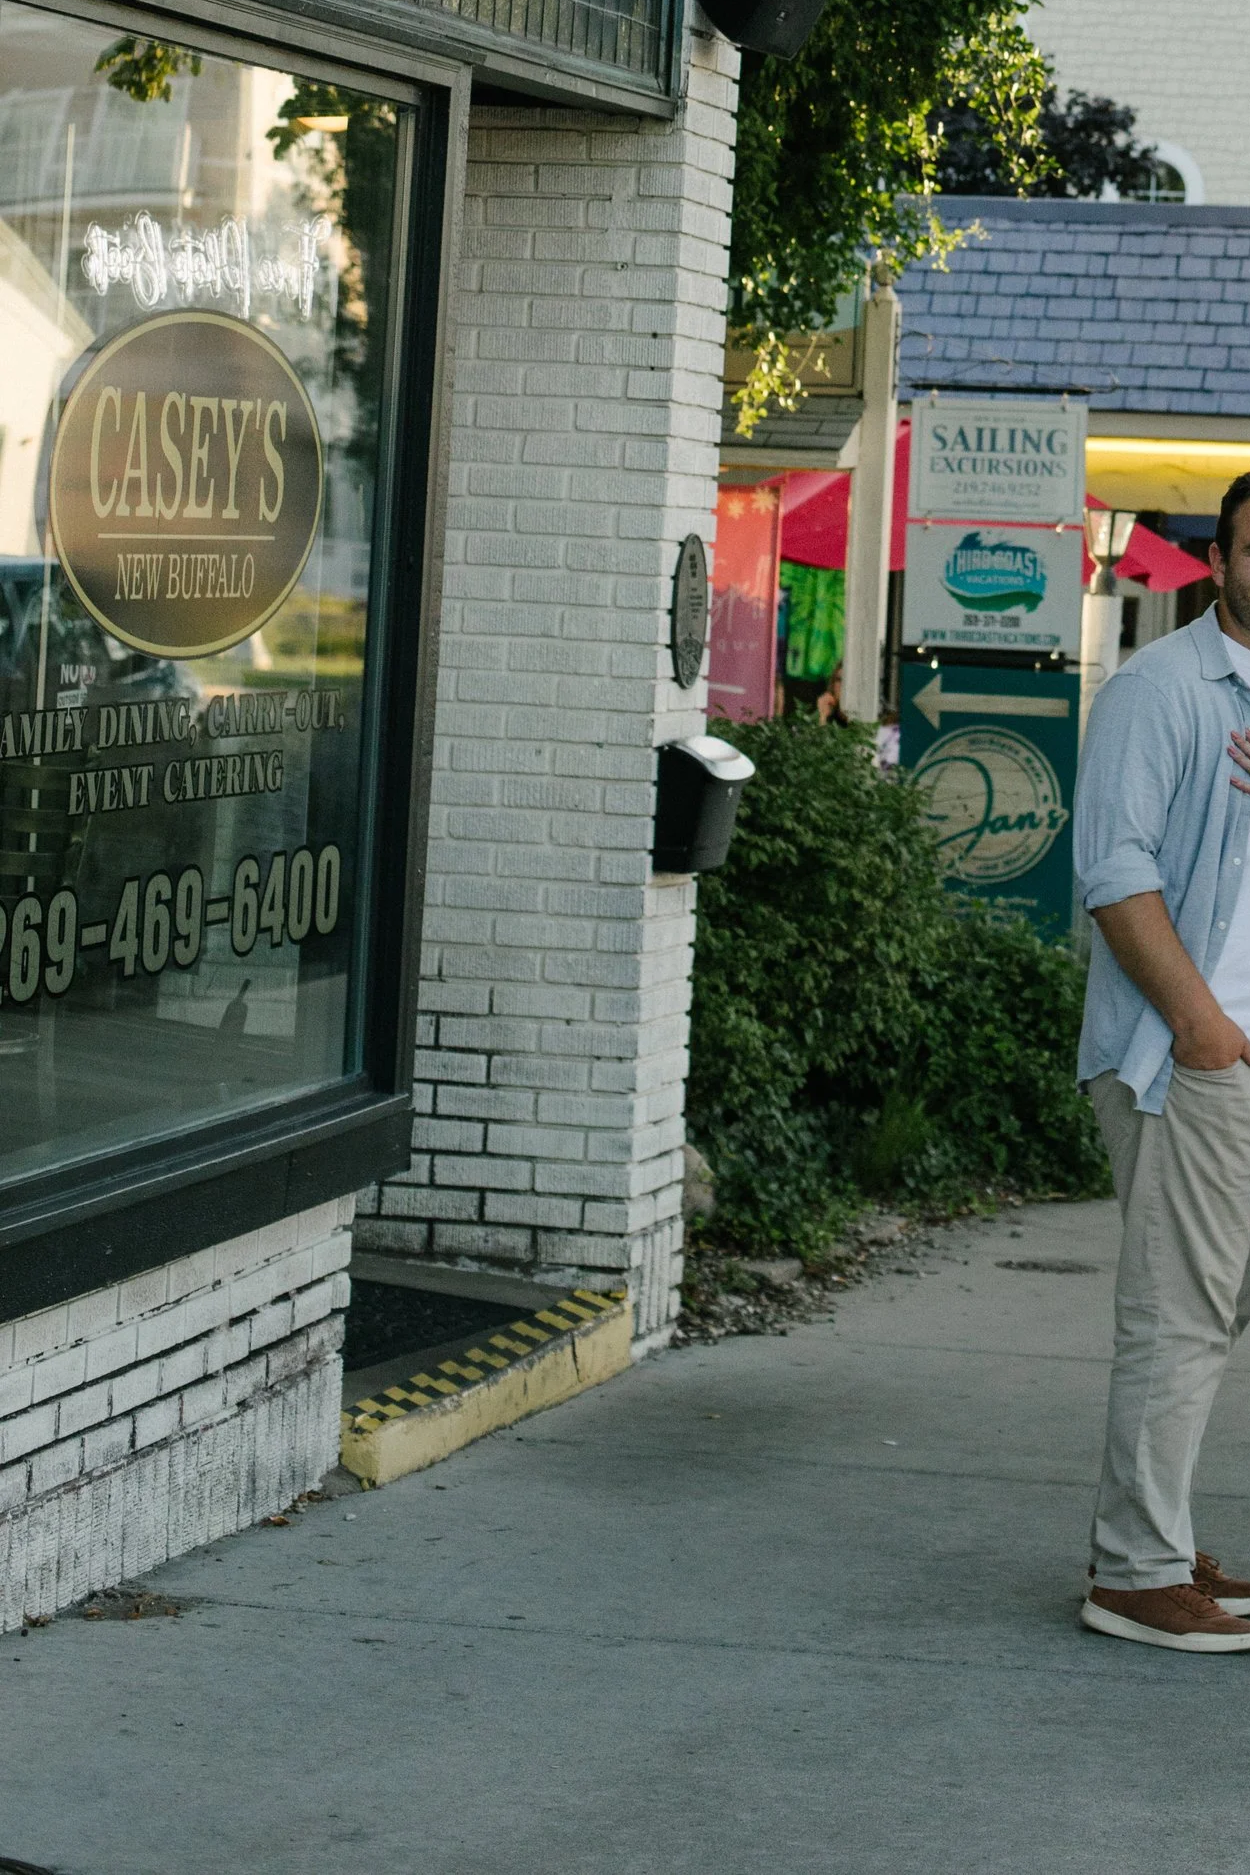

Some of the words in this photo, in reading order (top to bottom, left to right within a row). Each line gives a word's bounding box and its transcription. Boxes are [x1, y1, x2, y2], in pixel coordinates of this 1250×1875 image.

[90, 385, 287, 523] CASEY'S
[929, 456, 1067, 478] EXCURSIONS
[931, 424, 1069, 456] SAILING
[115, 553, 164, 601] NEW
[166, 552, 255, 600] BUFFALO
[97, 697, 198, 750] DINING,
[207, 689, 345, 739] CARRY-OUT,
[67, 762, 154, 816] EVENT
[163, 750, 284, 803] CATERING
[0, 842, 342, 1004] 69-469-6400
